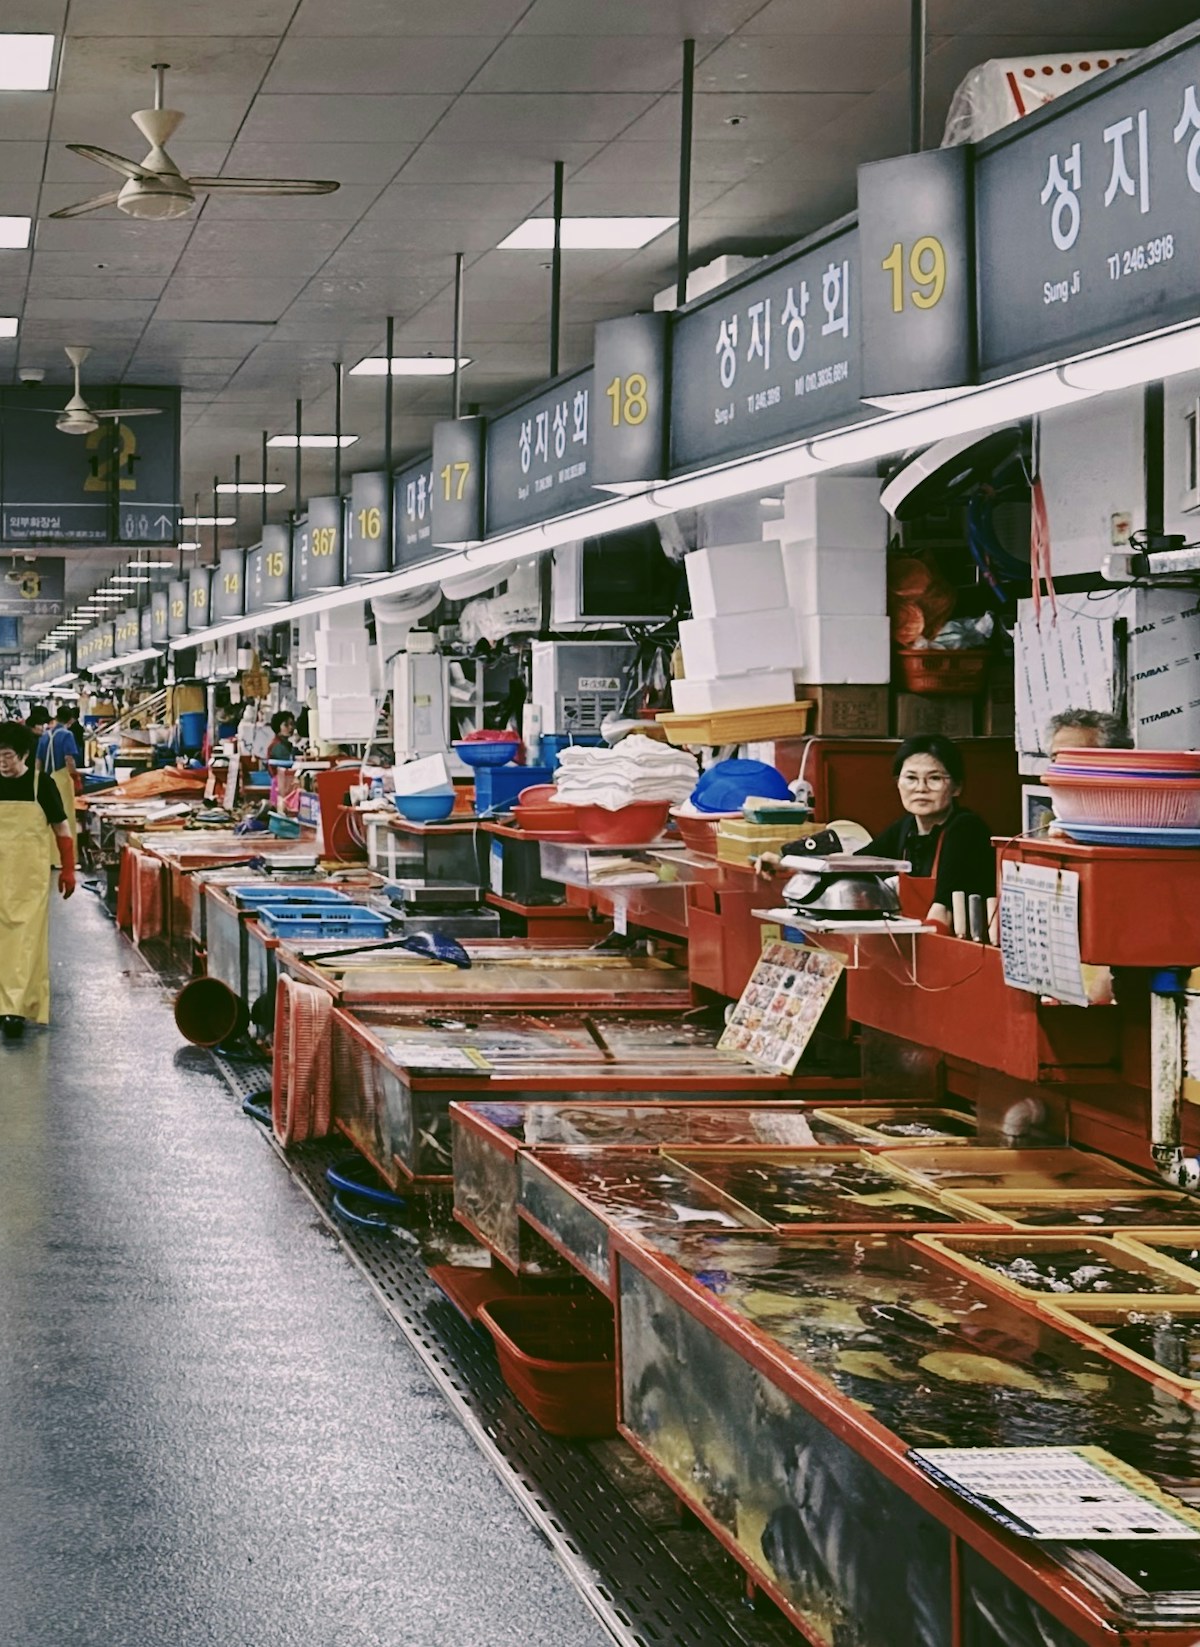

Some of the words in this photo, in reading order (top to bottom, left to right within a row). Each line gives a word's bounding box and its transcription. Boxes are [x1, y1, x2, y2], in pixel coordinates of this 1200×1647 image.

[881, 235, 948, 313] 19
[1043, 280, 1068, 304] Sung
[1070, 270, 1080, 295] Ji
[1123, 234, 1174, 276] 246.3918
[715, 260, 849, 389] 성지상회
[606, 372, 648, 427] 18
[518, 389, 589, 474] 성지상회
[82, 424, 137, 492] 2
[440, 461, 470, 501] 17
[9, 516, 61, 528] 외부화장실
[358, 507, 381, 540] 16
[311, 527, 337, 557] 367
[266, 552, 284, 577] 15
[19, 570, 41, 599] 3
[192, 588, 206, 608] 13
[223, 573, 239, 594] 14
[155, 610, 166, 625] 11
[171, 600, 184, 618] 12
[127, 622, 139, 636] 75
[1140, 705, 1183, 725] TITAMAX
